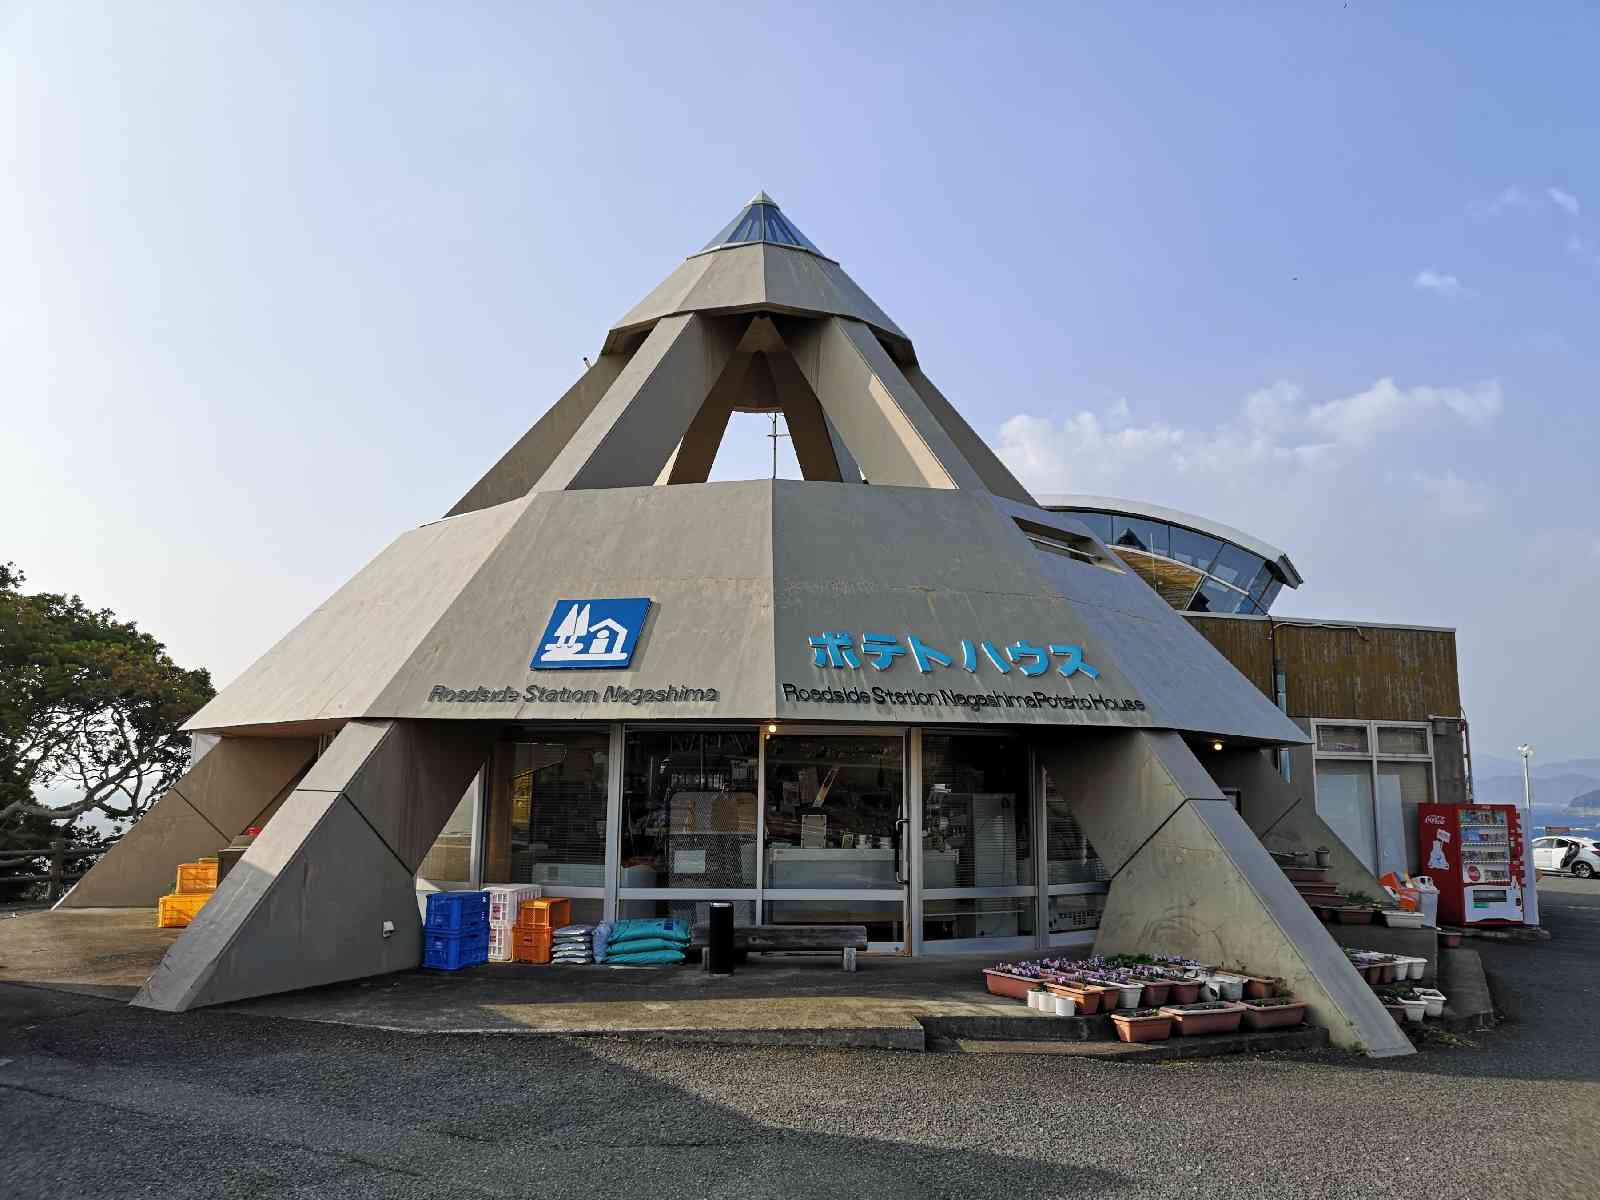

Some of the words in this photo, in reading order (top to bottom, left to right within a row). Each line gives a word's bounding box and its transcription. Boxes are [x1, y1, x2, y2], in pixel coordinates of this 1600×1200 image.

[808, 631, 1098, 680] ポテトハウス
[522, 684, 598, 703] Station
[602, 684, 720, 705] Nagashima
[782, 682, 871, 704] Roadside
[871, 686, 939, 706] Station
